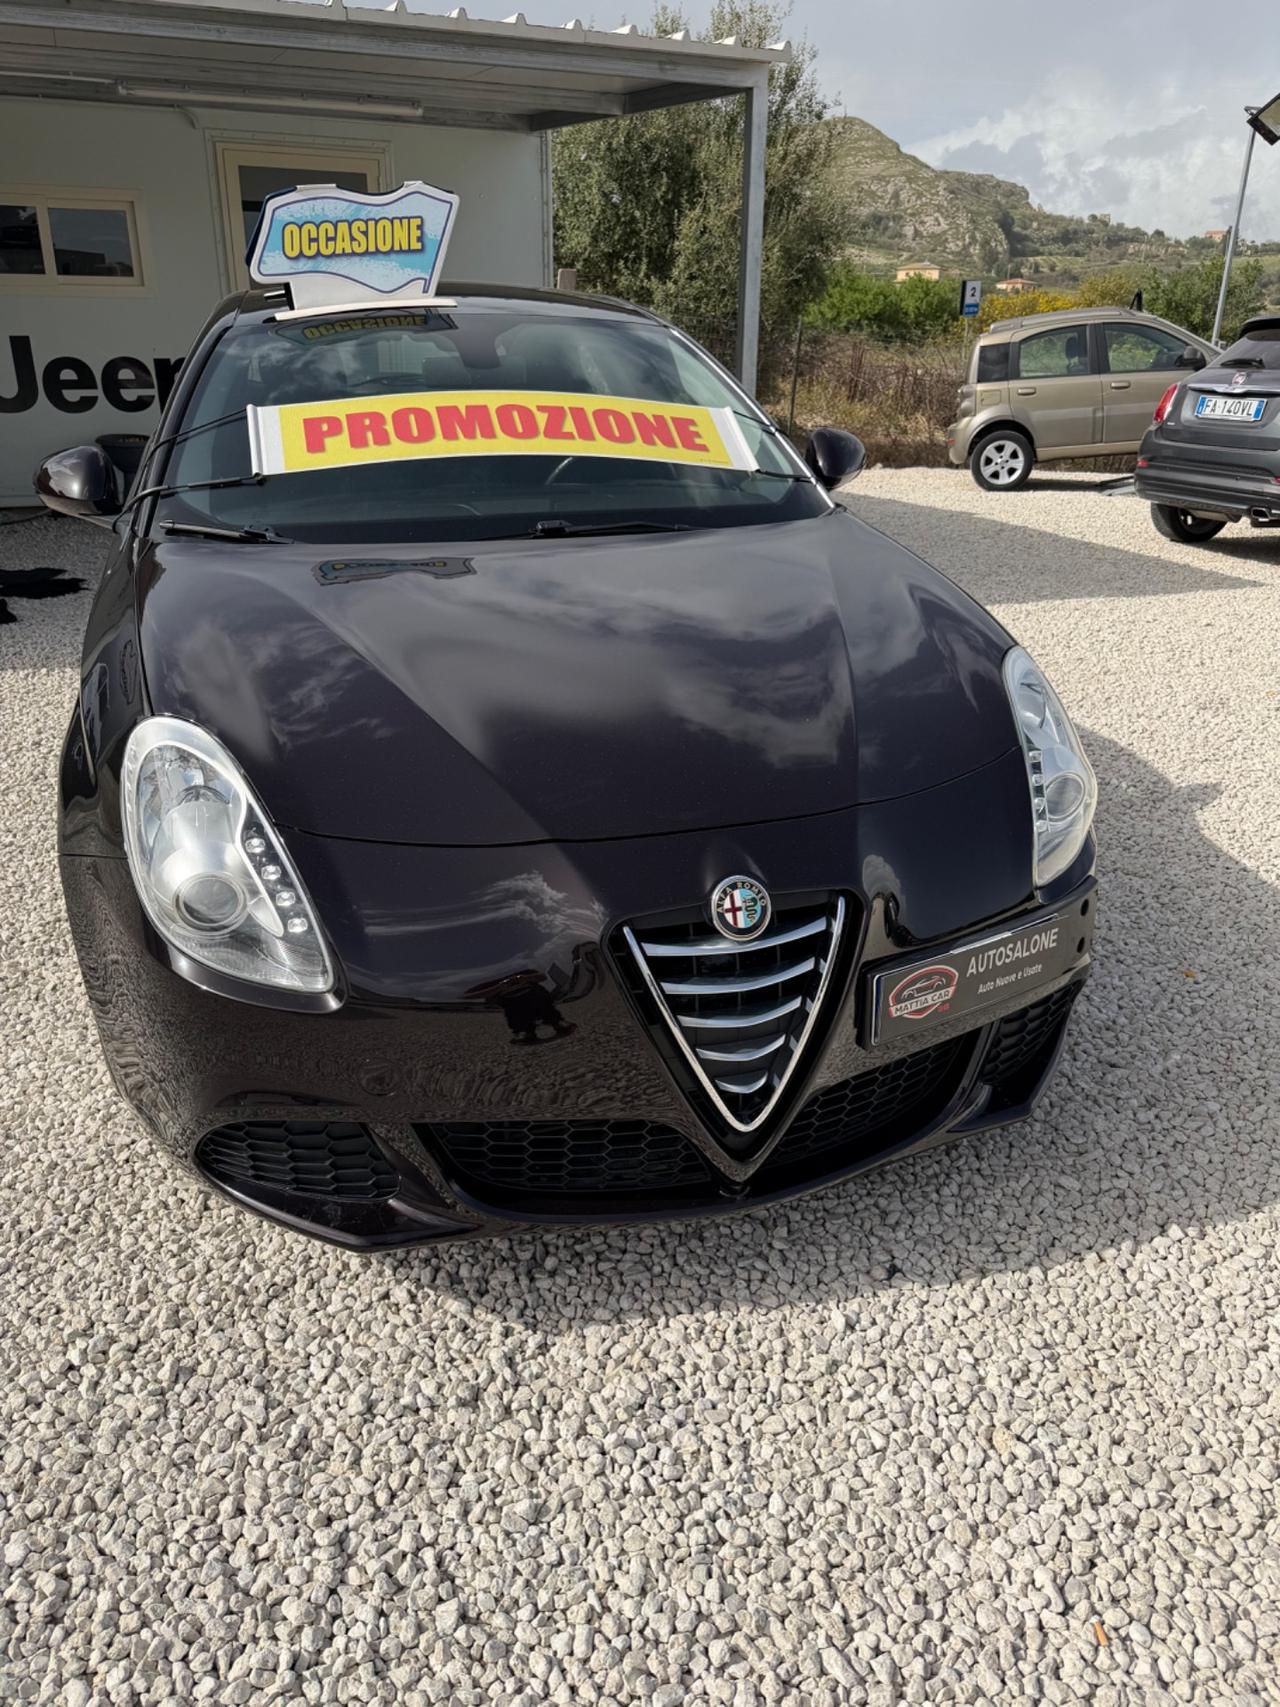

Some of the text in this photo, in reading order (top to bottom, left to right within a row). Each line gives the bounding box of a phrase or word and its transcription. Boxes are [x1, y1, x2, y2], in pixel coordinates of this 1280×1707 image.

[283, 216, 423, 259] OCCASIONE
[970, 286, 977, 298] 2
[1203, 399, 1253, 416] FA 140VL
[303, 403, 710, 453] PROMOZIONE
[716, 882, 766, 913] ALFA ROMEO
[966, 927, 1059, 978] AUTOSALONE
[977, 982, 995, 995] Auto
[1023, 963, 1043, 978] Usate
[894, 998, 930, 1014] MATTIA
[930, 989, 950, 1003] CAR
